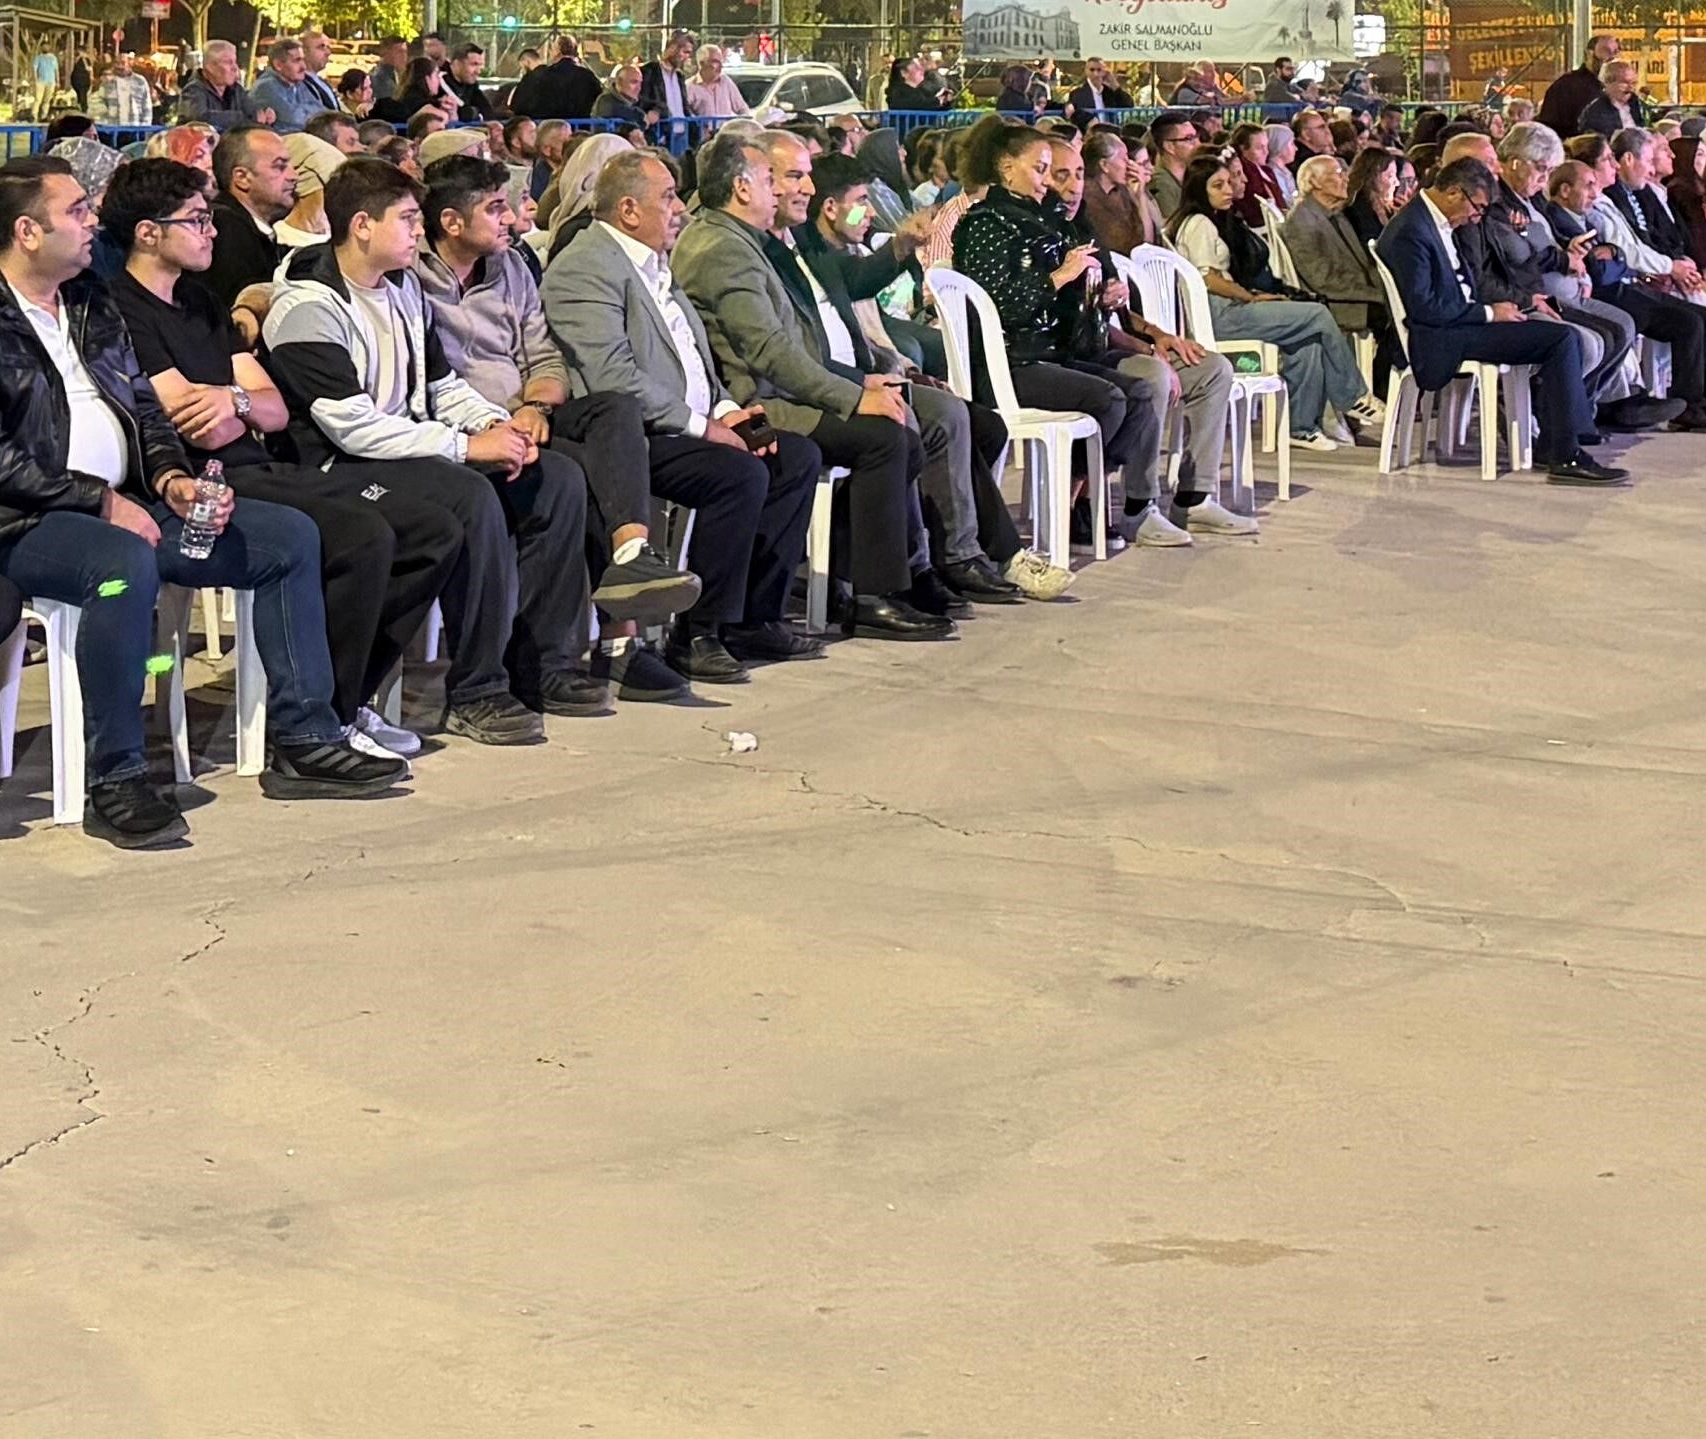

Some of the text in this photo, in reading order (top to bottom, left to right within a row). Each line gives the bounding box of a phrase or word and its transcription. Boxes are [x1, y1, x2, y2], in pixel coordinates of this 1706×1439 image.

[1099, 22, 1213, 36] ZAKİR SALMANOĞLU
[1111, 38, 1202, 53] GENEL BAŞKAN
